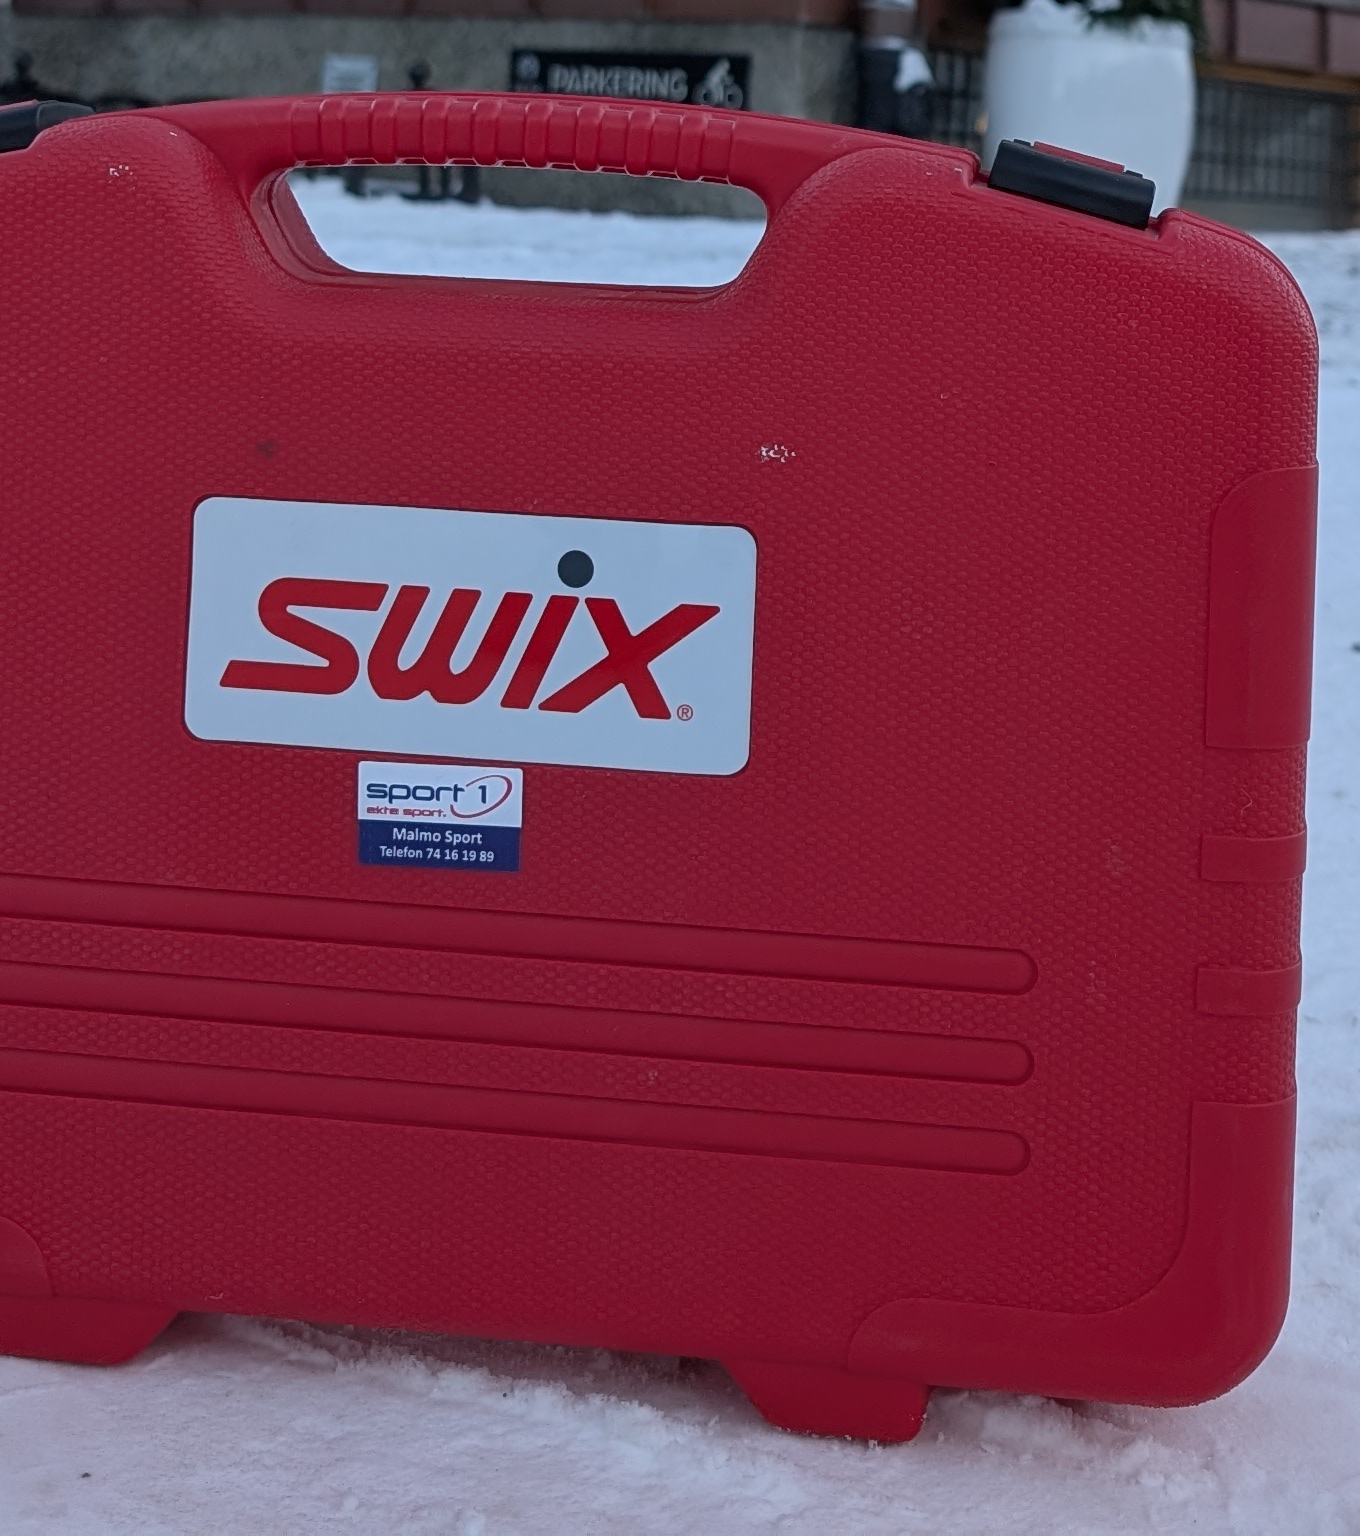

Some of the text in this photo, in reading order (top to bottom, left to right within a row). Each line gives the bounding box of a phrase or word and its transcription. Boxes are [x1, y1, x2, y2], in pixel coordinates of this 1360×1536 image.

[546, 63, 689, 102] PARKERING
[366, 783, 466, 804] sport
[366, 805, 399, 815] ekte
[392, 827, 483, 846] Malmo Sport
[379, 845, 495, 862] Telefon 74 16 19 89
